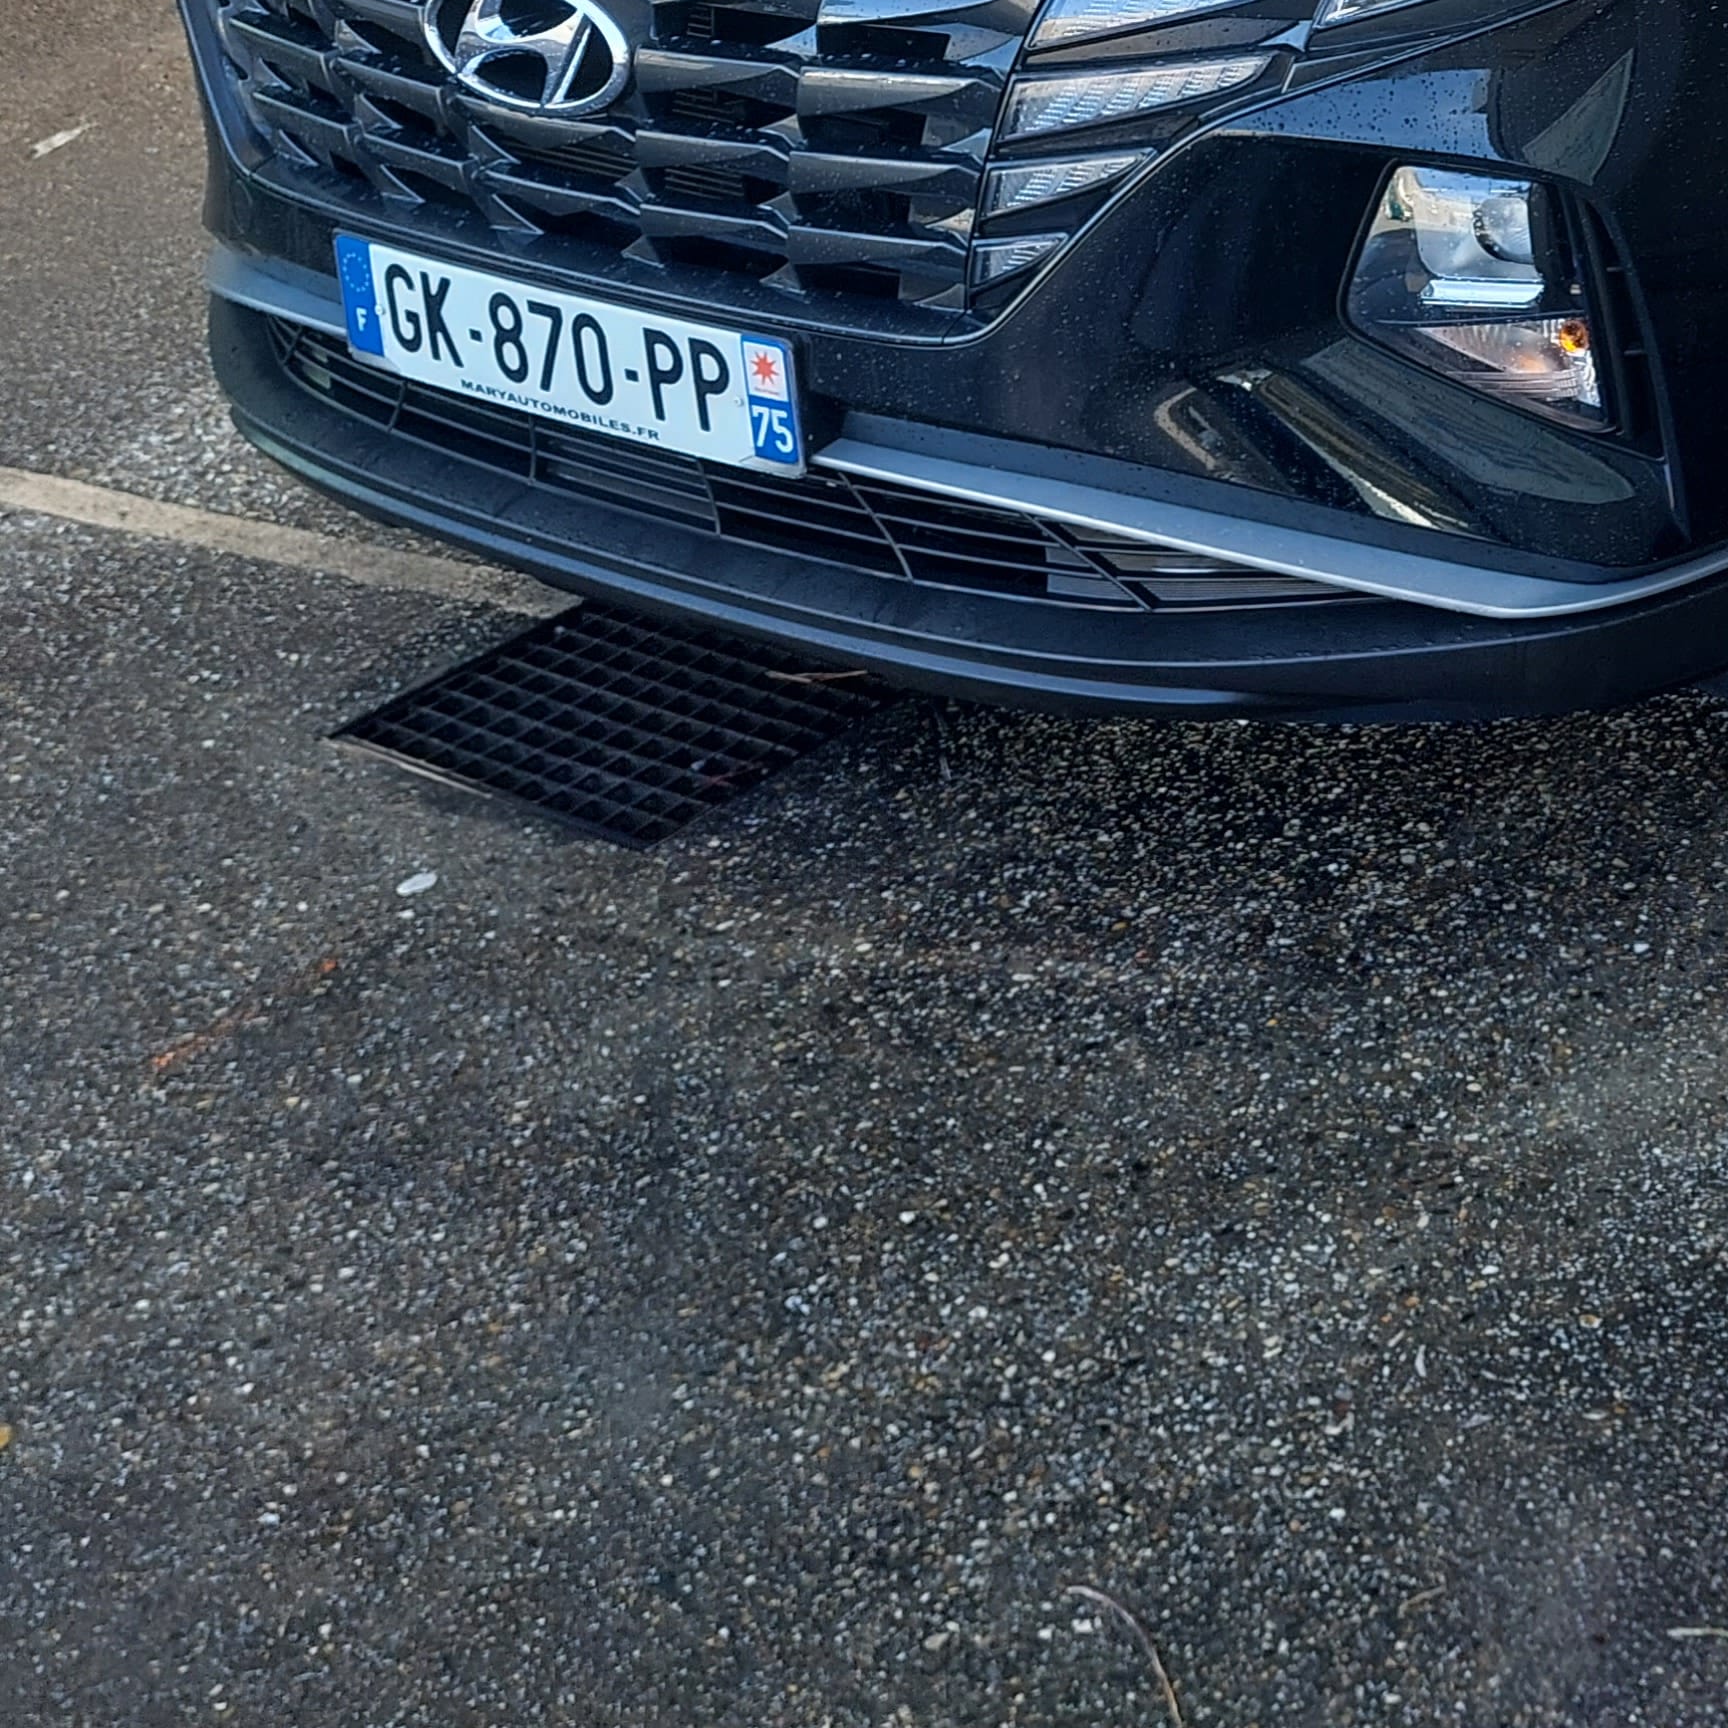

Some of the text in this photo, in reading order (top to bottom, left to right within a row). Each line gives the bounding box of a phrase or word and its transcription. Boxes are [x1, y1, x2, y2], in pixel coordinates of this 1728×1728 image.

[355, 307, 367, 332] F
[384, 263, 730, 432] GK-870-PP
[460, 379, 660, 440] MARYAUTOMOBILES.FR
[751, 405, 794, 454] 75
